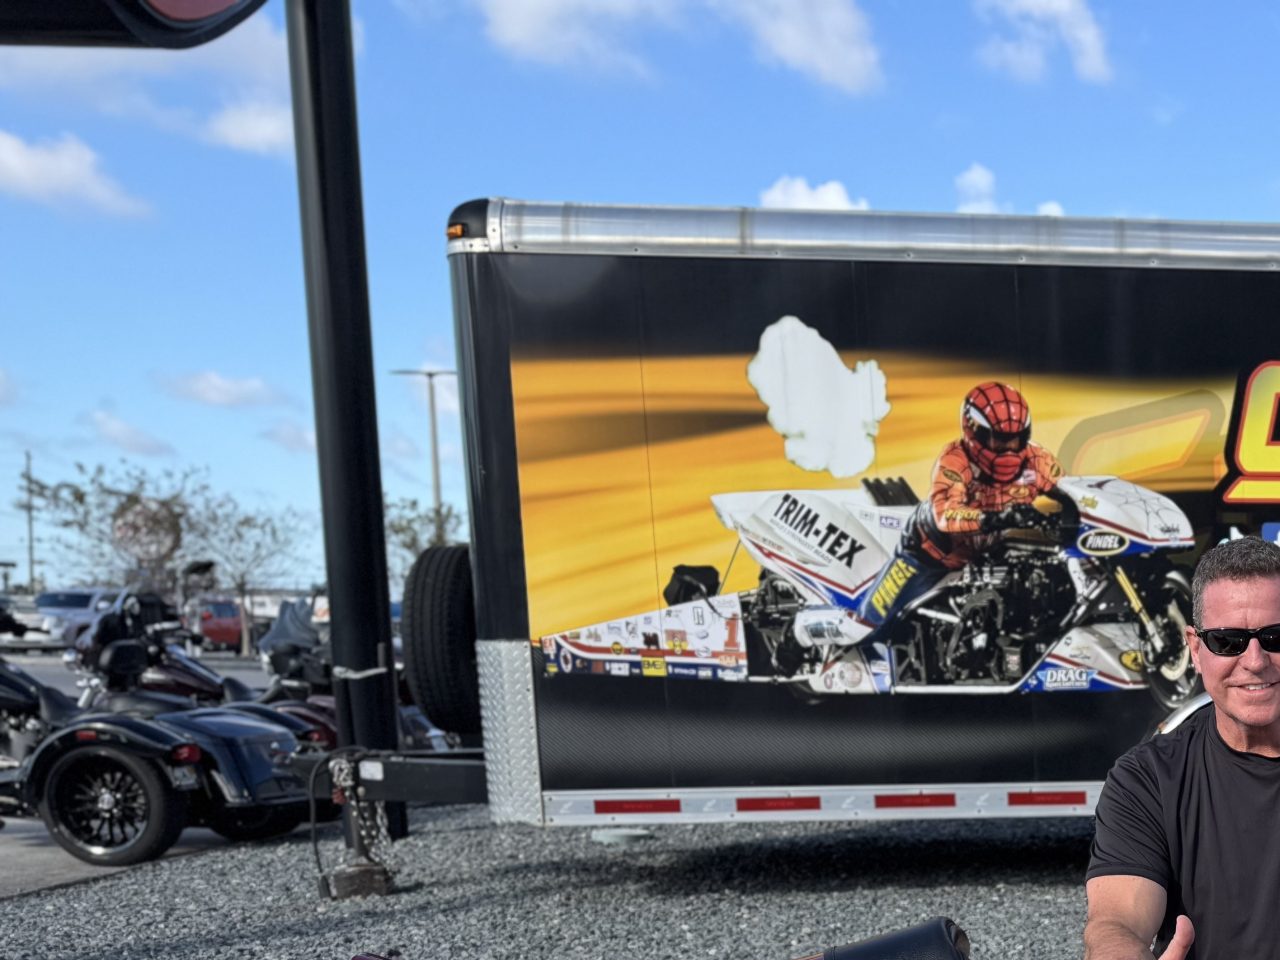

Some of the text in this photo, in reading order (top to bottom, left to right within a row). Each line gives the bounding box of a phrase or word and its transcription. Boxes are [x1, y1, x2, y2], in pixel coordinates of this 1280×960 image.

[774, 493, 867, 569] TRIM-TEX
[1085, 531, 1120, 549] PINGEL
[1046, 668, 1088, 683] DRAG
